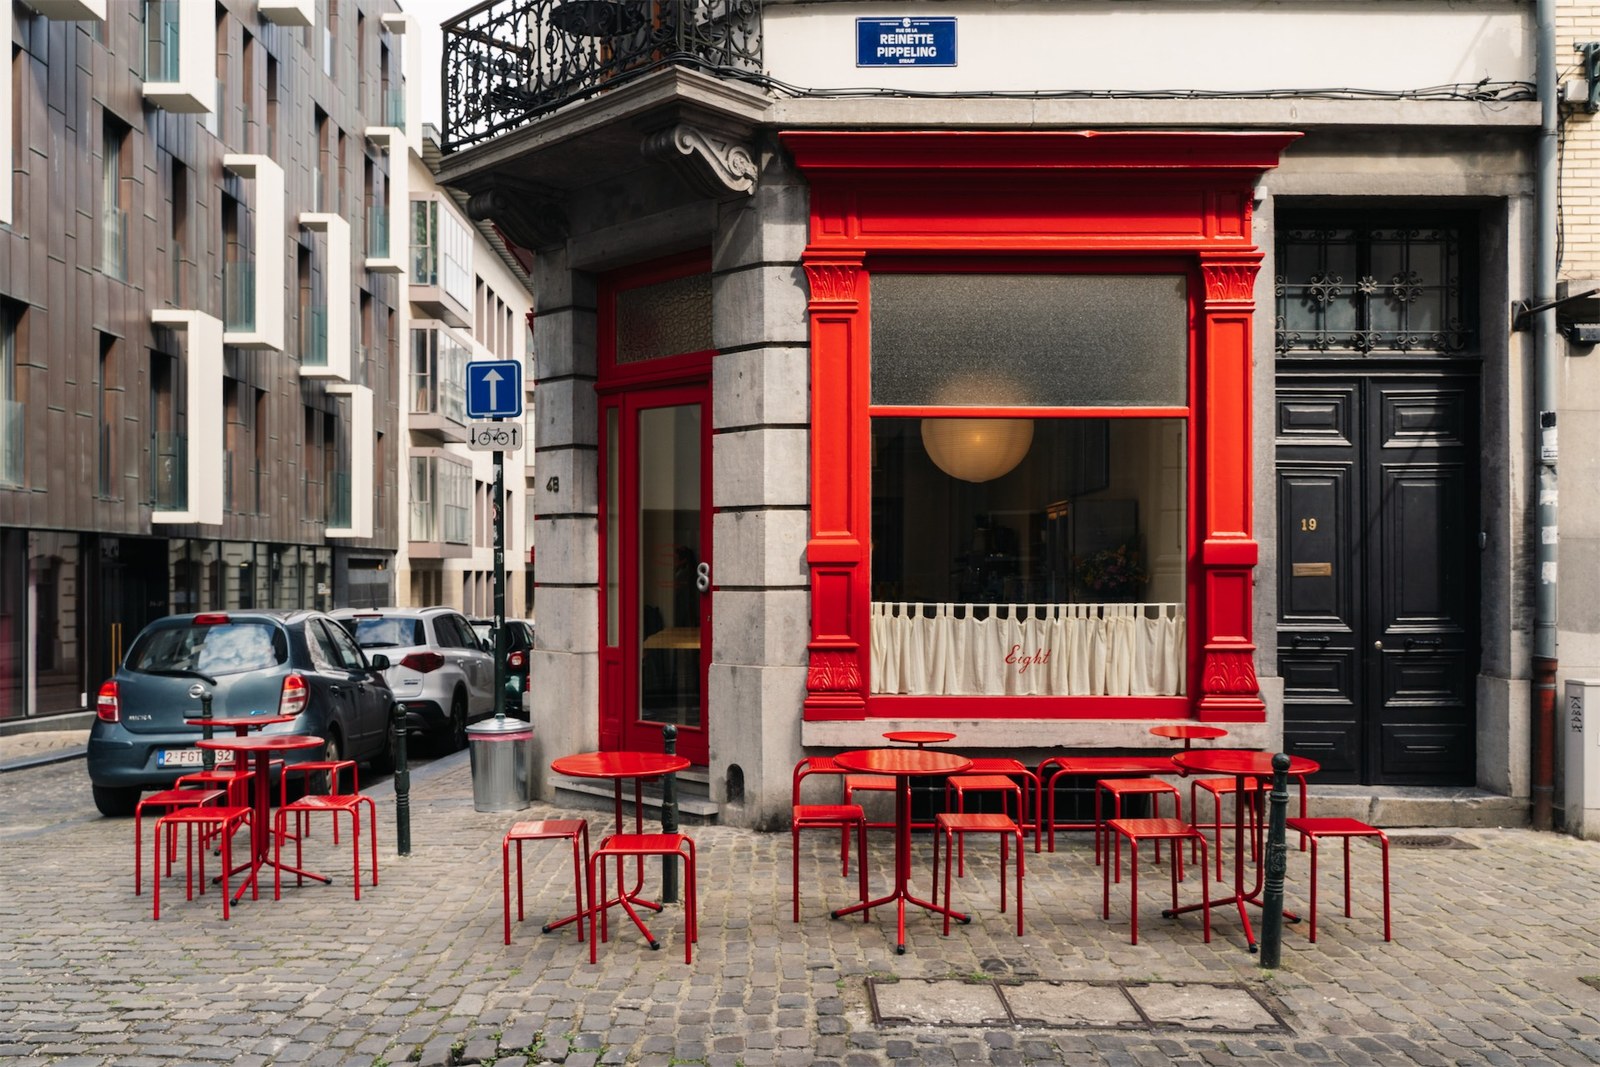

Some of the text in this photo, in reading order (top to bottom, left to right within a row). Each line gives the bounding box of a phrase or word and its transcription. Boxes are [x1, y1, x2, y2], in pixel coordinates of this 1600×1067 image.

[880, 34, 934, 44] REINETTE
[877, 47, 937, 57] PIPPELING
[1301, 518, 1317, 531] 19
[1005, 644, 1051, 674] Eight
